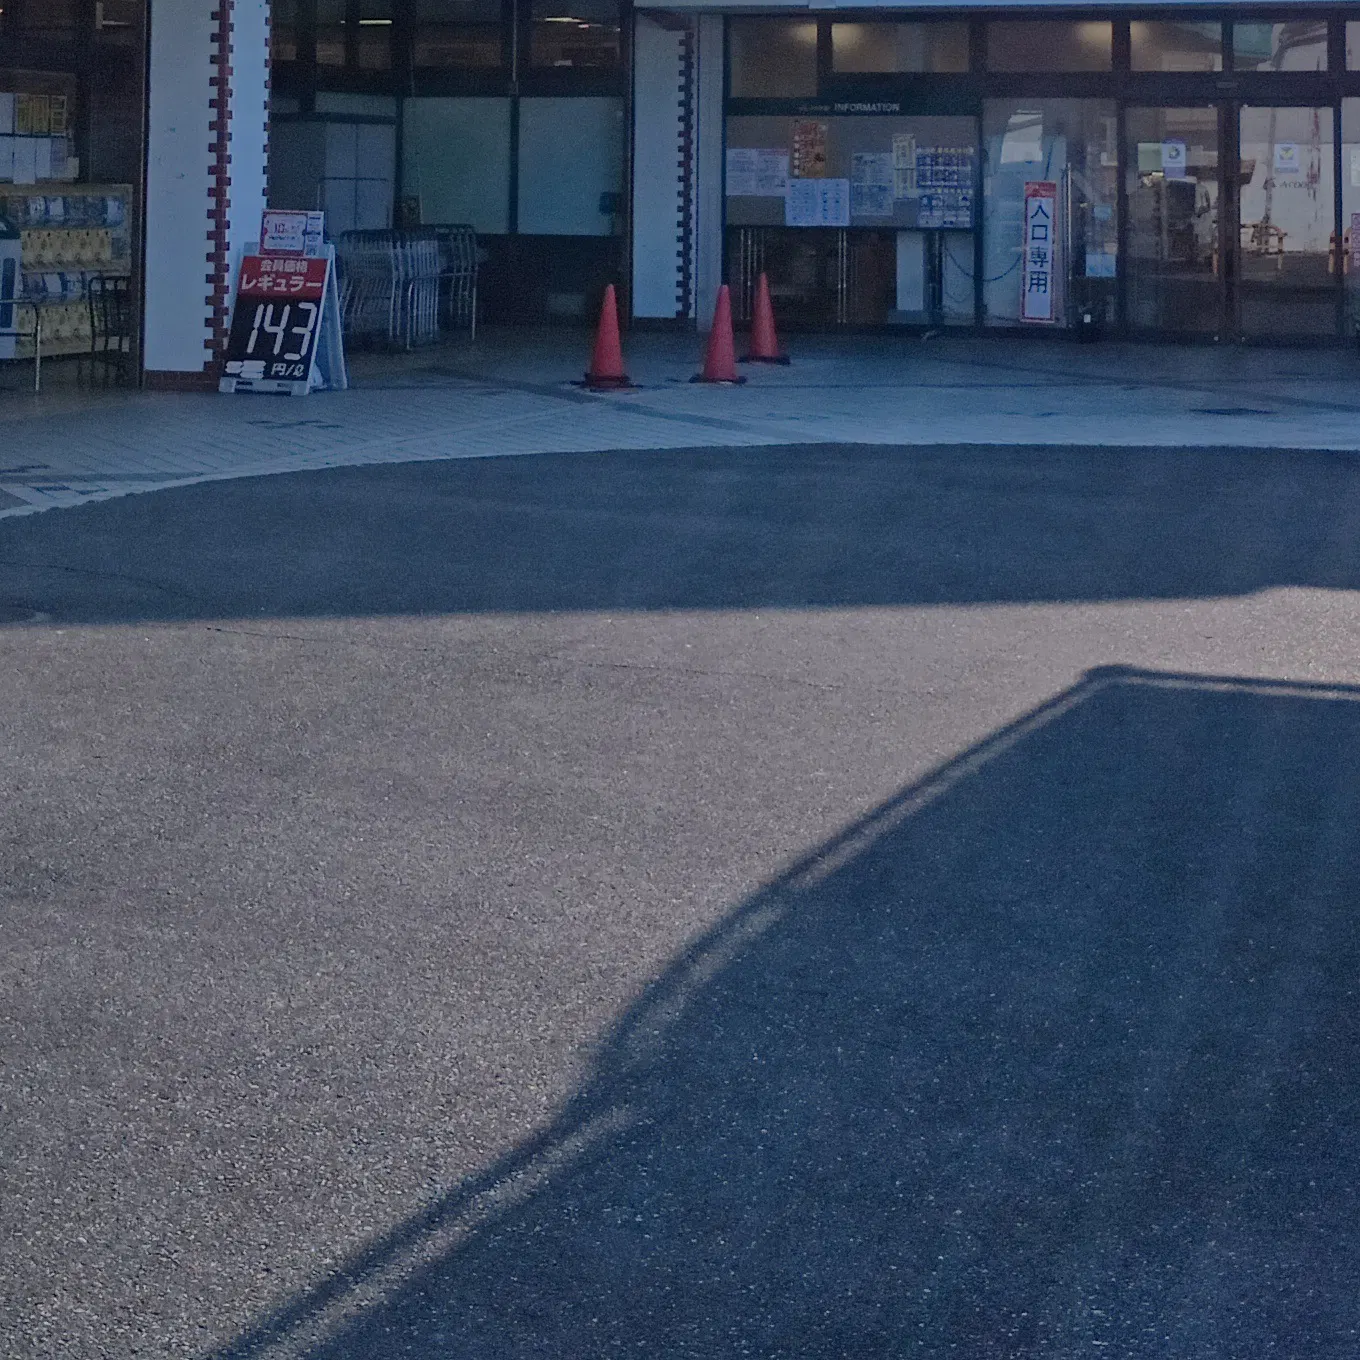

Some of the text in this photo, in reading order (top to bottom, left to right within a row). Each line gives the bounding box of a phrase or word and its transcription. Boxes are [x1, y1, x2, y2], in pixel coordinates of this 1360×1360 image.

[834, 102, 900, 113] INFORMATION
[1028, 204, 1051, 294] 入口専用
[260, 259, 309, 273] 会員価格
[241, 274, 323, 291] レギュラー
[246, 302, 318, 361] 143
